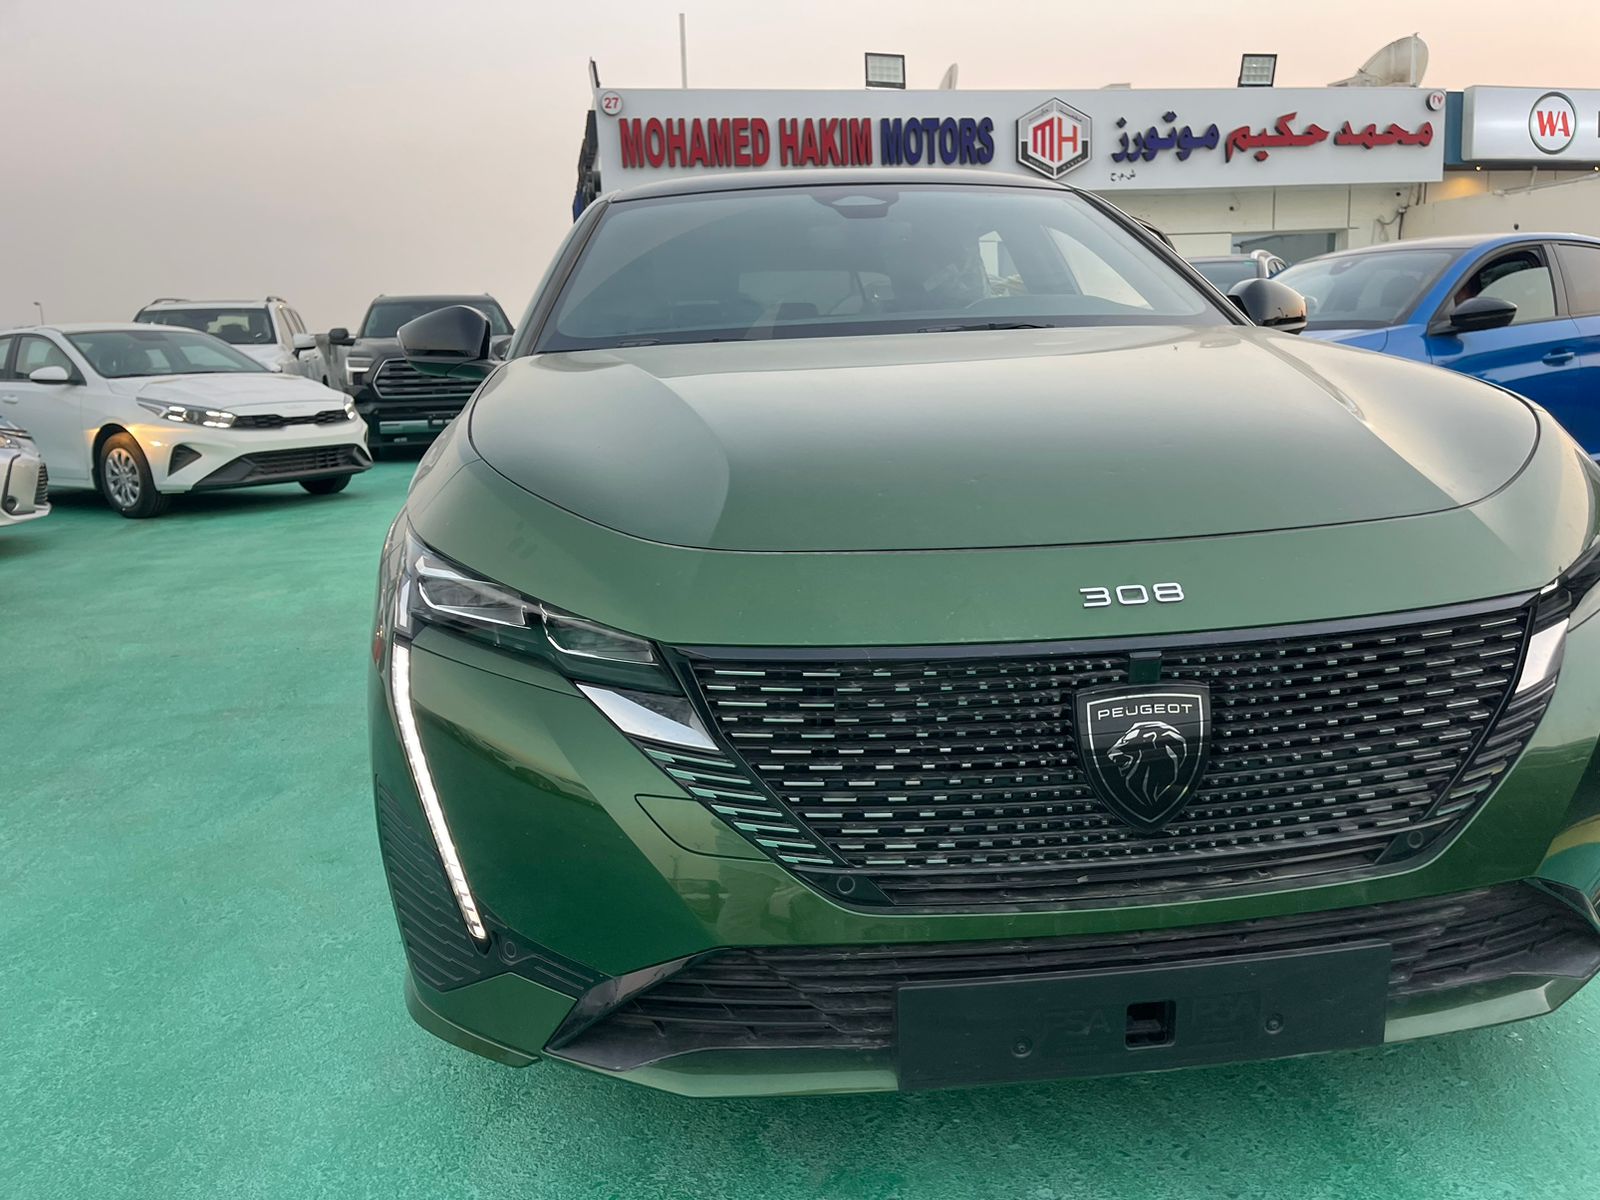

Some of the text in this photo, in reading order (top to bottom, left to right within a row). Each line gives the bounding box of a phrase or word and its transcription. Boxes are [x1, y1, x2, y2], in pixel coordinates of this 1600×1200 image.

[604, 97, 619, 109] 27
[1111, 110, 1433, 163] محمد حكيم موتورز
[1536, 110, 1570, 137] WA
[619, 117, 994, 168] MOHAMED HAKIM MOTORS
[1032, 115, 1078, 163] MH
[1080, 582, 1185, 608] 308
[1097, 703, 1193, 720] PEUGEOT
